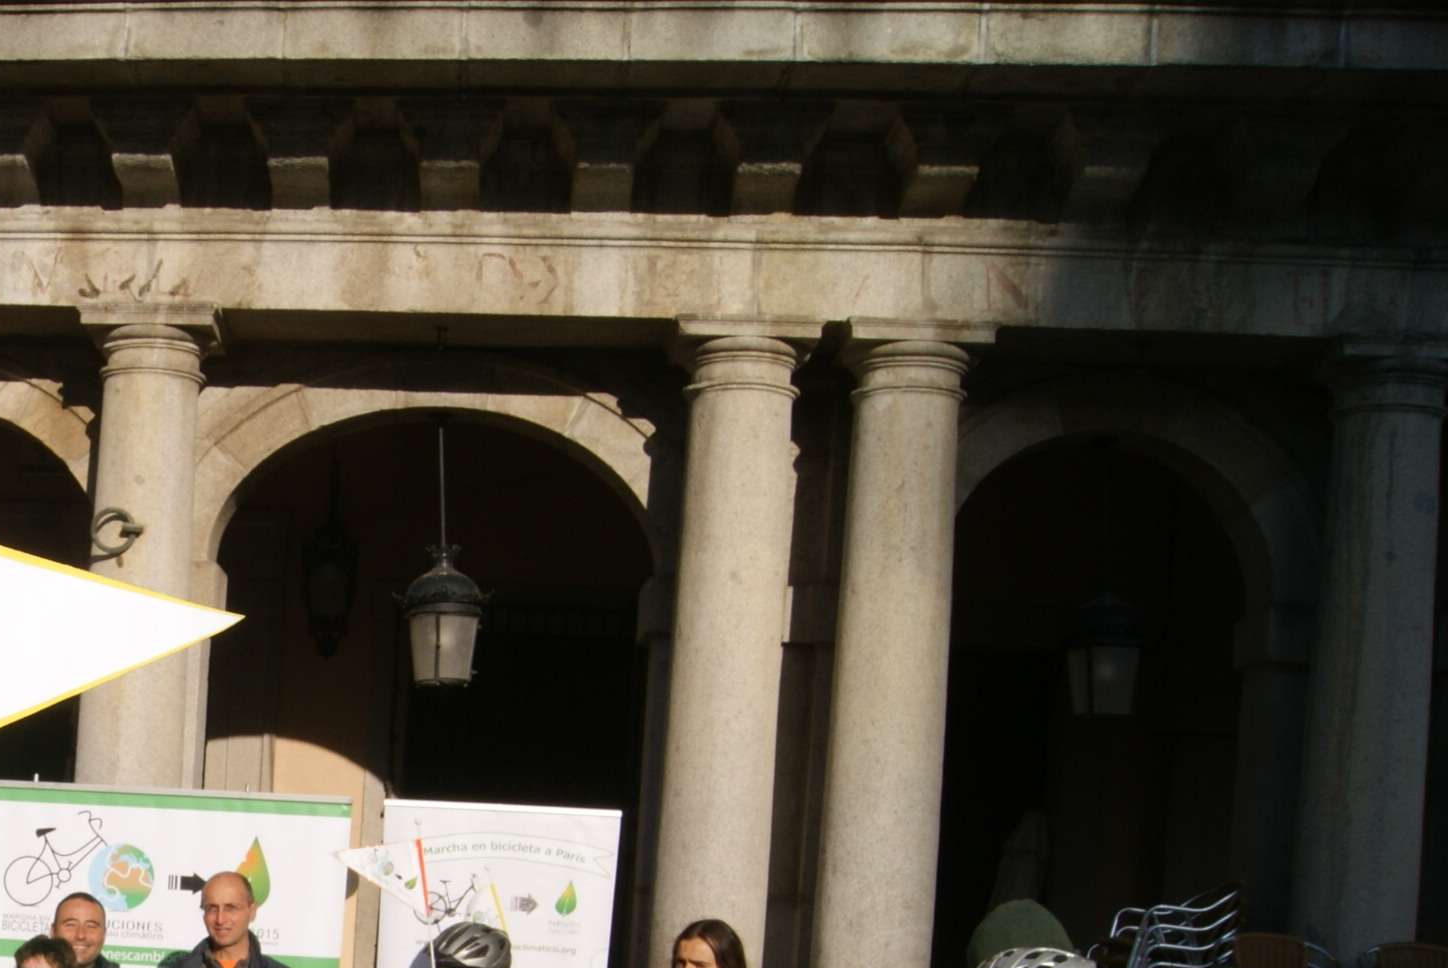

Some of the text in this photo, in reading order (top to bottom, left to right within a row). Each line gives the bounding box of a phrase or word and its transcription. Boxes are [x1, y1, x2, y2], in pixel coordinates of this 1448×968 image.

[424, 843, 468, 856] Marcha
[471, 843, 486, 851] en
[490, 840, 541, 856] bicicleta
